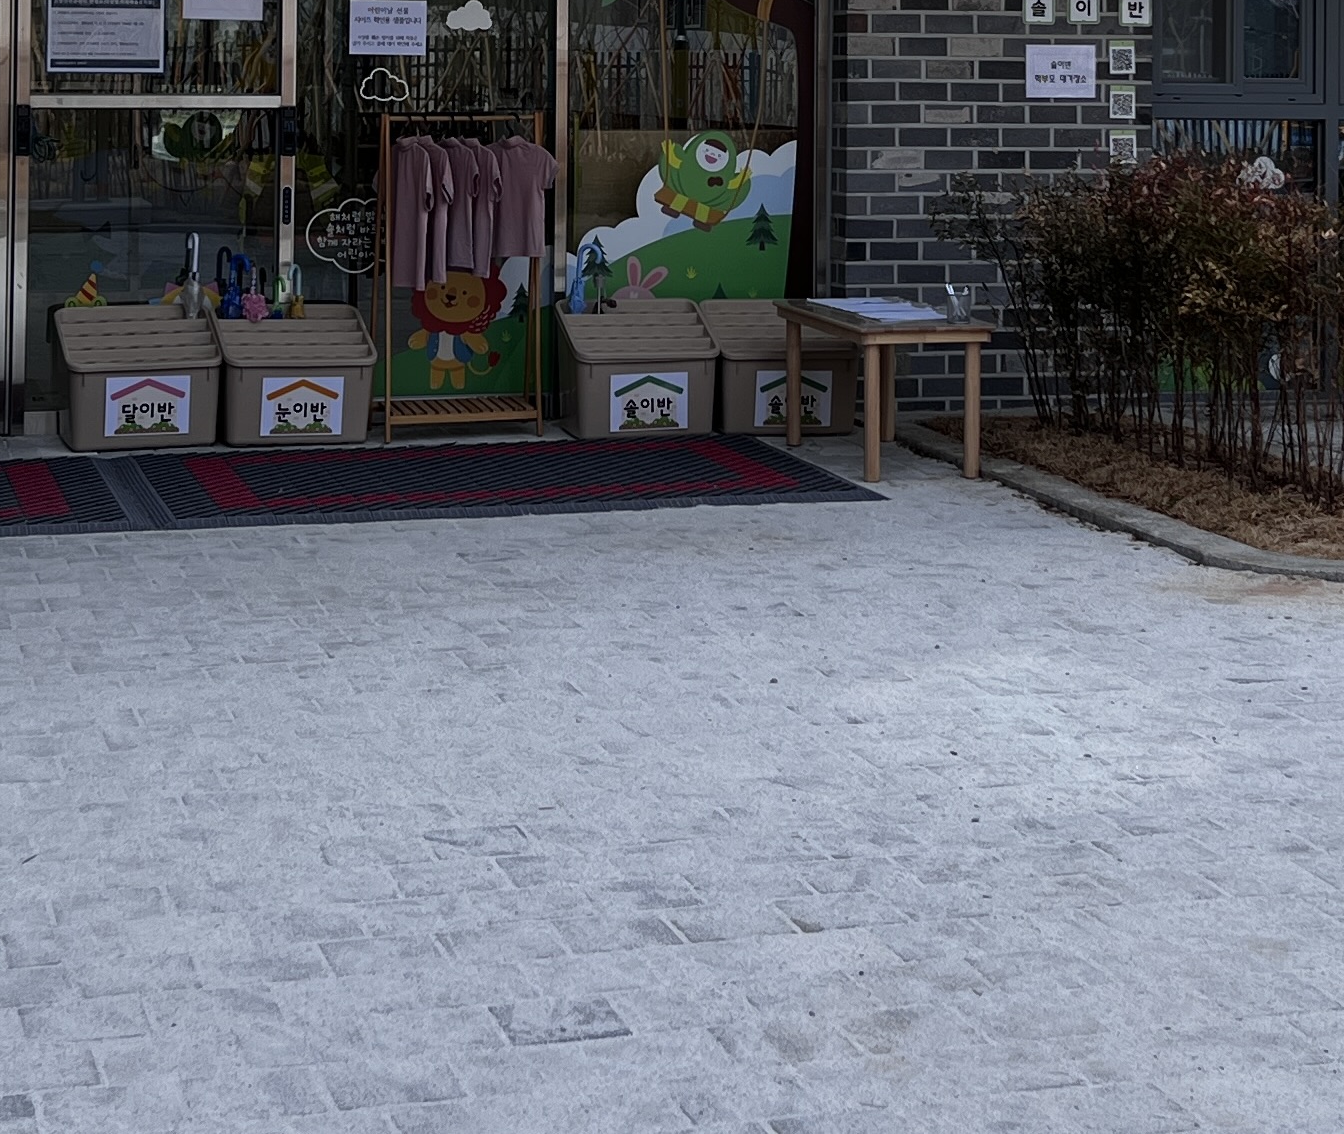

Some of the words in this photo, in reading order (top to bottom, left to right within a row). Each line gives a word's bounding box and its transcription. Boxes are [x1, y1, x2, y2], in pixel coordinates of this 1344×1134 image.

[316, 236, 339, 248] 함께
[341, 236, 373, 249] 자라는
[121, 401, 175, 424] 달이반
[274, 401, 327, 423] 눈이반
[623, 396, 673, 419] 솔이반
